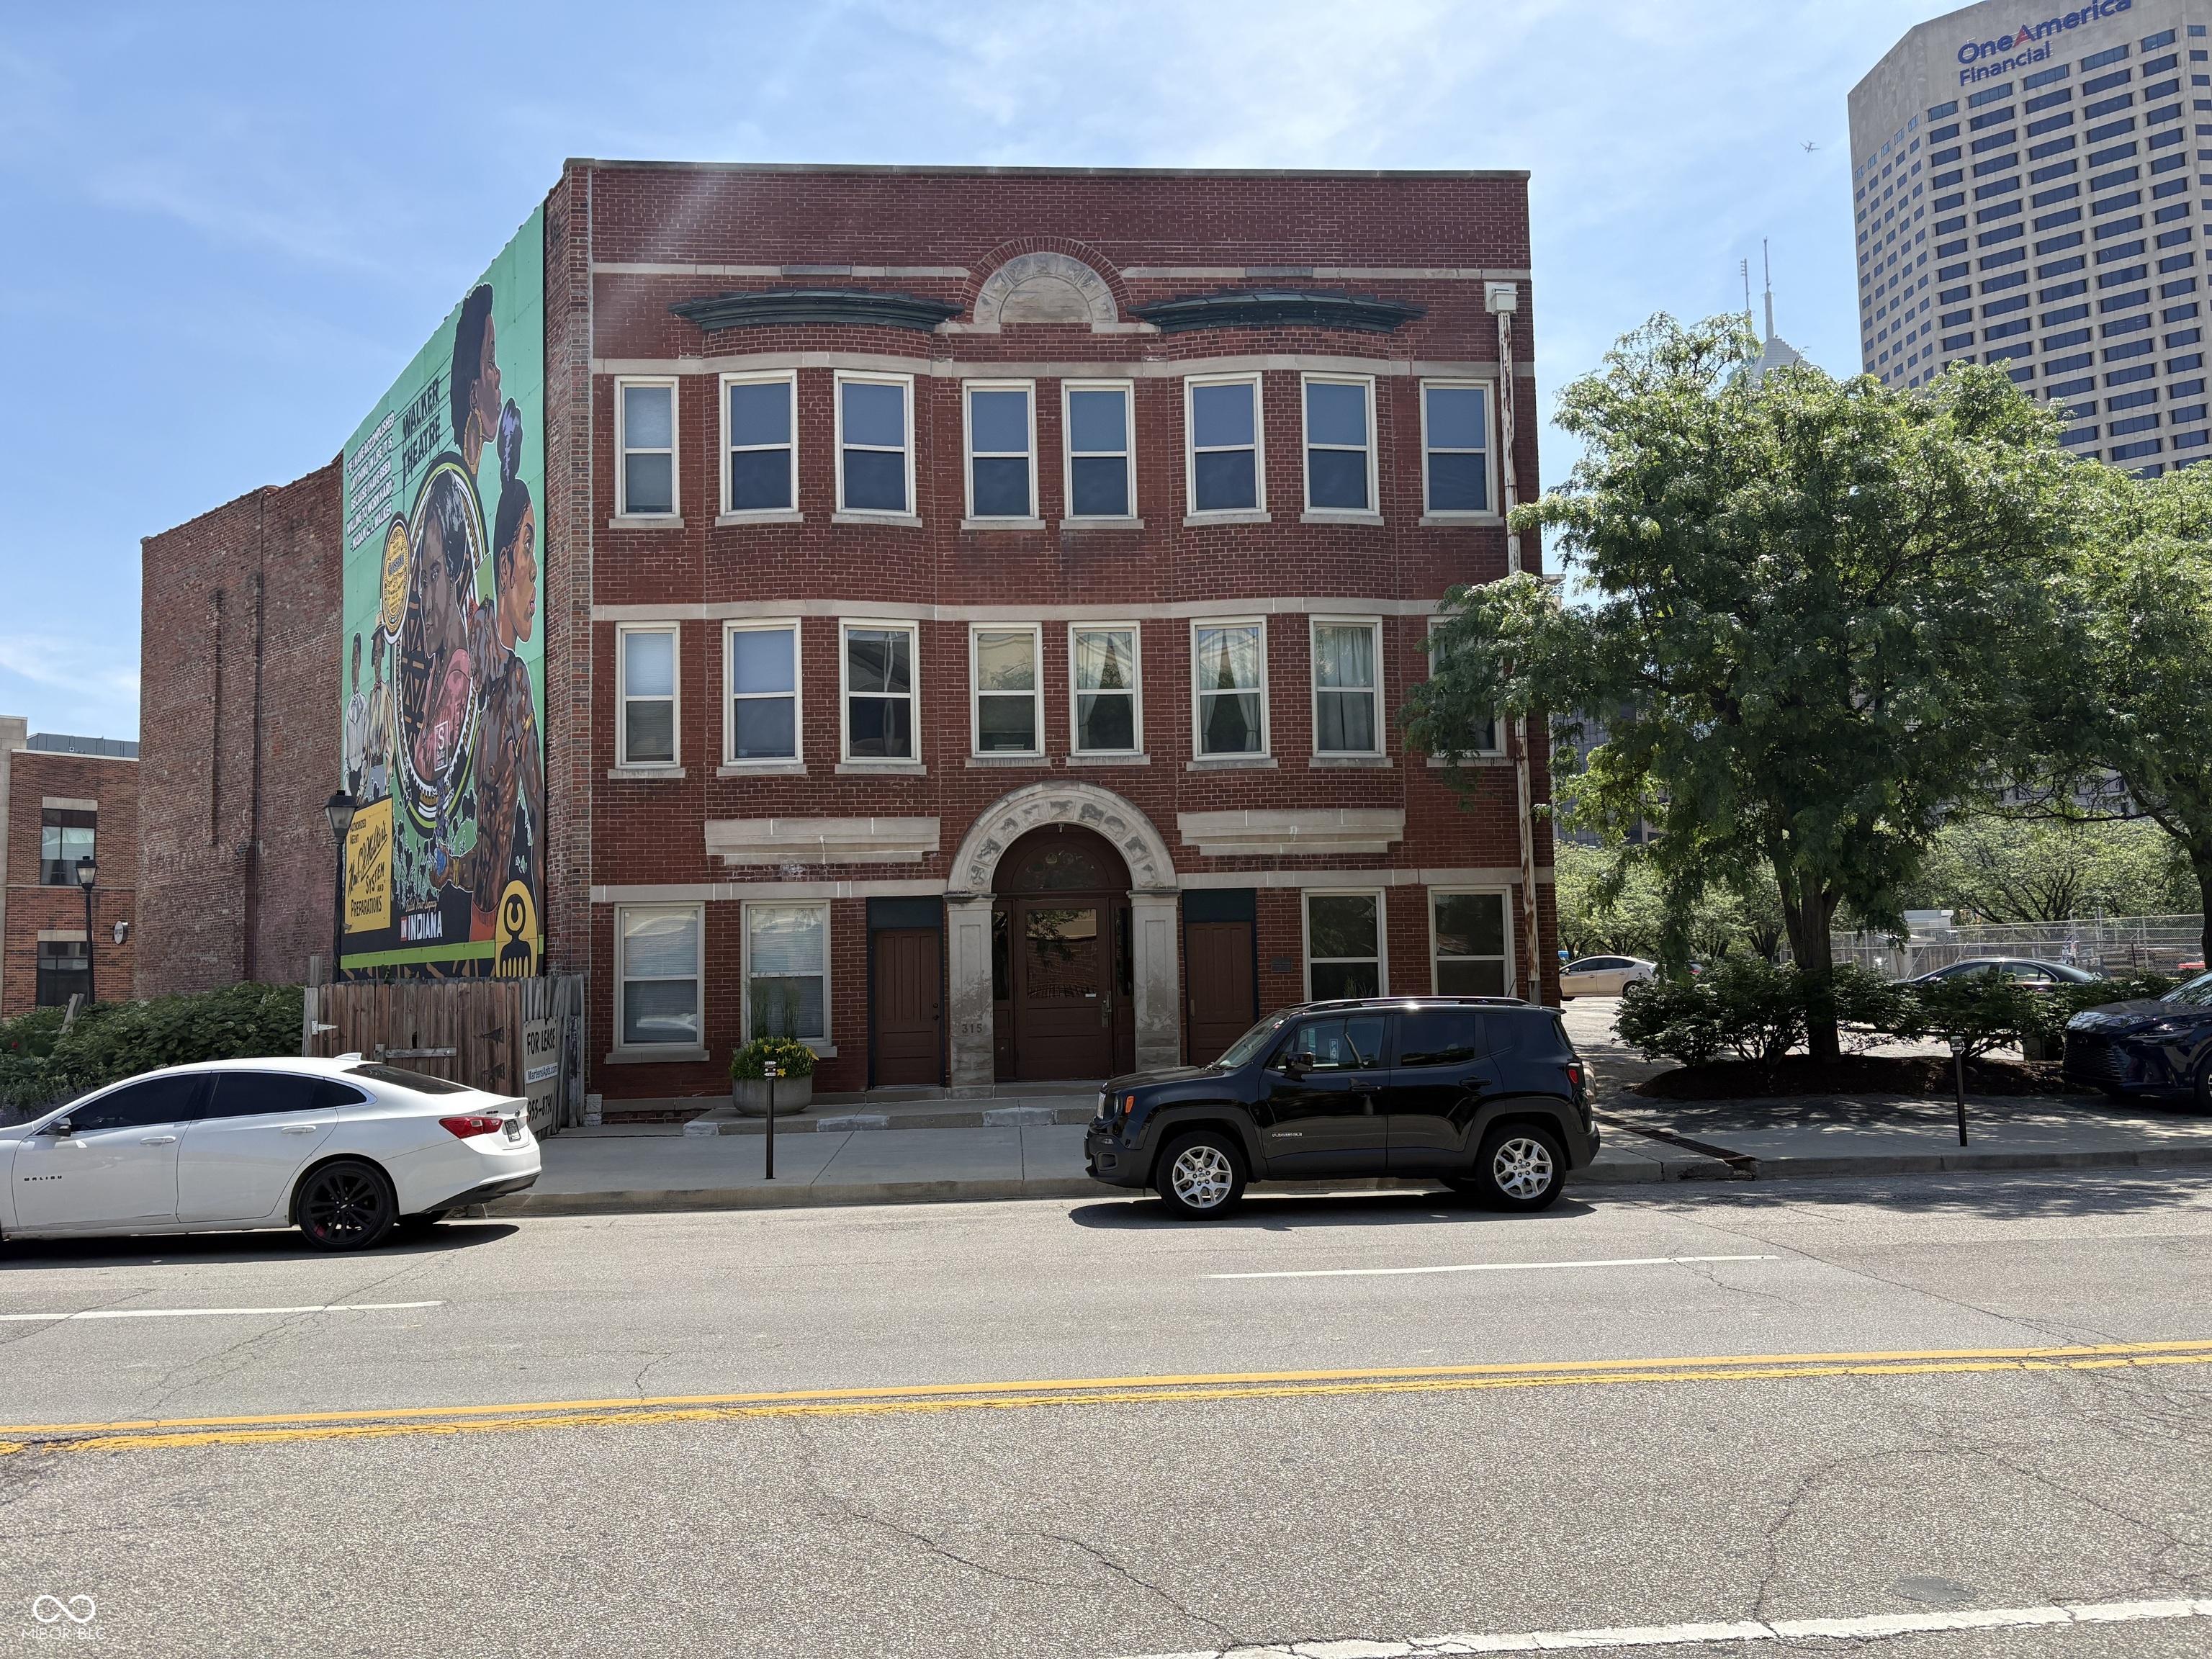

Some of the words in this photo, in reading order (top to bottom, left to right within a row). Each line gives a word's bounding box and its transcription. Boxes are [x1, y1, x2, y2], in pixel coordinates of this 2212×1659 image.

[1958, 0, 2131, 64] OneAmerica
[1960, 41, 2051, 86] Financial
[403, 377, 440, 441] WALKER
[401, 413, 441, 477] THEATRE
[401, 920, 407, 938] IN
[408, 910, 443, 941] INDIANA
[527, 1031, 539, 1056] FOR
[541, 1028, 555, 1052] LEASE
[962, 1023, 983, 1033] 315
